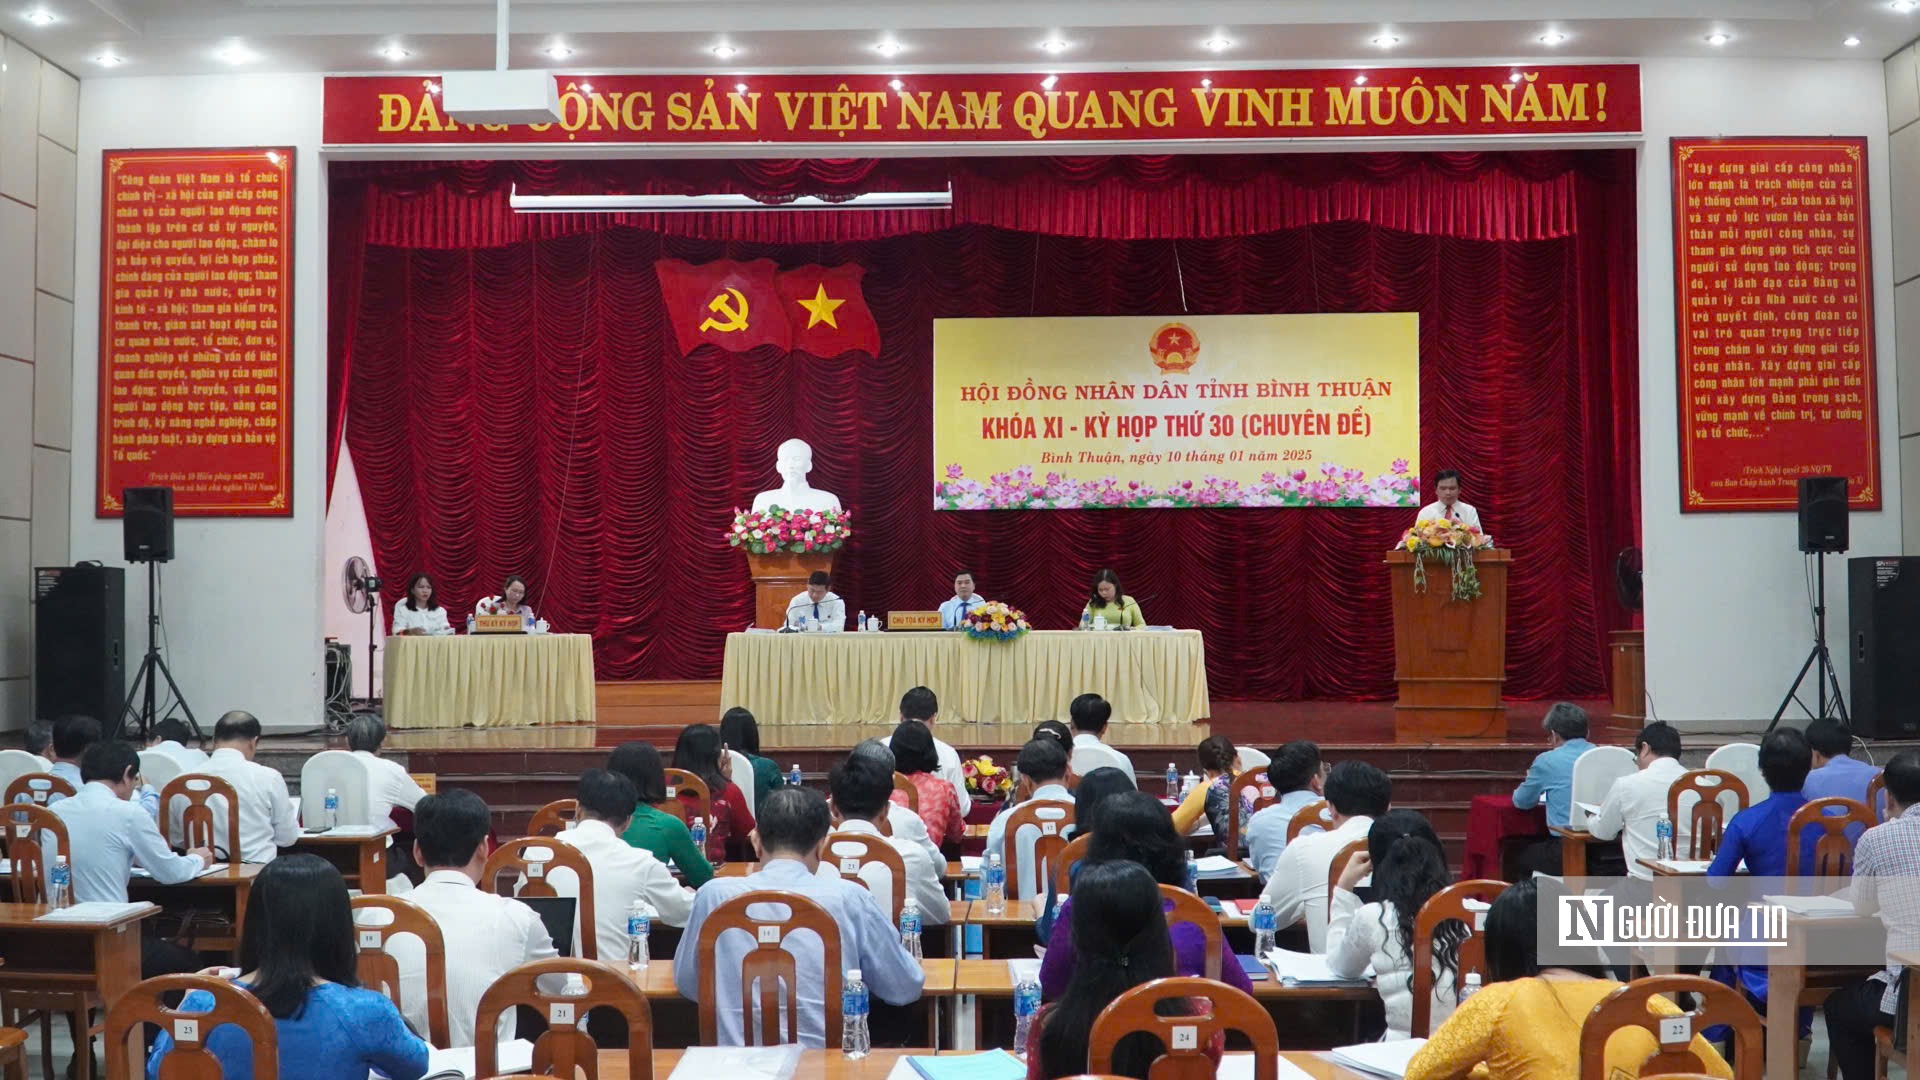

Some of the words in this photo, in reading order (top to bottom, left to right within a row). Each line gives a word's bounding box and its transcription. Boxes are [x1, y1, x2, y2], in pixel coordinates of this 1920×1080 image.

[379, 79, 508, 131] ĐẢ
[530, 83, 655, 140] ỘNG
[667, 78, 761, 131] SẢN
[775, 84, 887, 137] VIỆT
[899, 91, 1002, 129] NAM
[1013, 89, 1177, 139] QUANG
[1192, 87, 1313, 127] VINH
[1326, 77, 1469, 125] MUÔN
[1481, 71, 1606, 123] NĂM!
[961, 382, 1000, 404] HỘI
[1007, 377, 1067, 401] ĐỒNG
[1075, 381, 1135, 400] NHÂN
[1143, 380, 1188, 399] DÂN
[1196, 378, 1248, 398] TỈNH
[1256, 378, 1310, 397] BÌNH
[1317, 378, 1392, 400] THUẬN
[982, 412, 1036, 439] KHÓA
[1043, 416, 1063, 438] XI
[1084, 411, 1110, 438] KỲ
[1117, 415, 1157, 442] HỌP
[1164, 410, 1205, 437] THỨ
[1209, 415, 1234, 437] 30
[1241, 409, 1331, 438] (CHUYÊN
[1337, 405, 1371, 437] ĐỀ)
[1040, 452, 1073, 464] Bình
[1077, 452, 1125, 465] Thuận,
[1129, 452, 1162, 466] ngày
[1167, 451, 1182, 463] 10
[1185, 450, 1224, 464] tháng
[1229, 450, 1243, 461] 01
[1248, 450, 1278, 461] năm
[1282, 450, 1312, 461] 2025
[183, 1026, 193, 1034] 23
[1180, 1033, 1190, 1041] 24
[1672, 1025, 1684, 1035] 22
